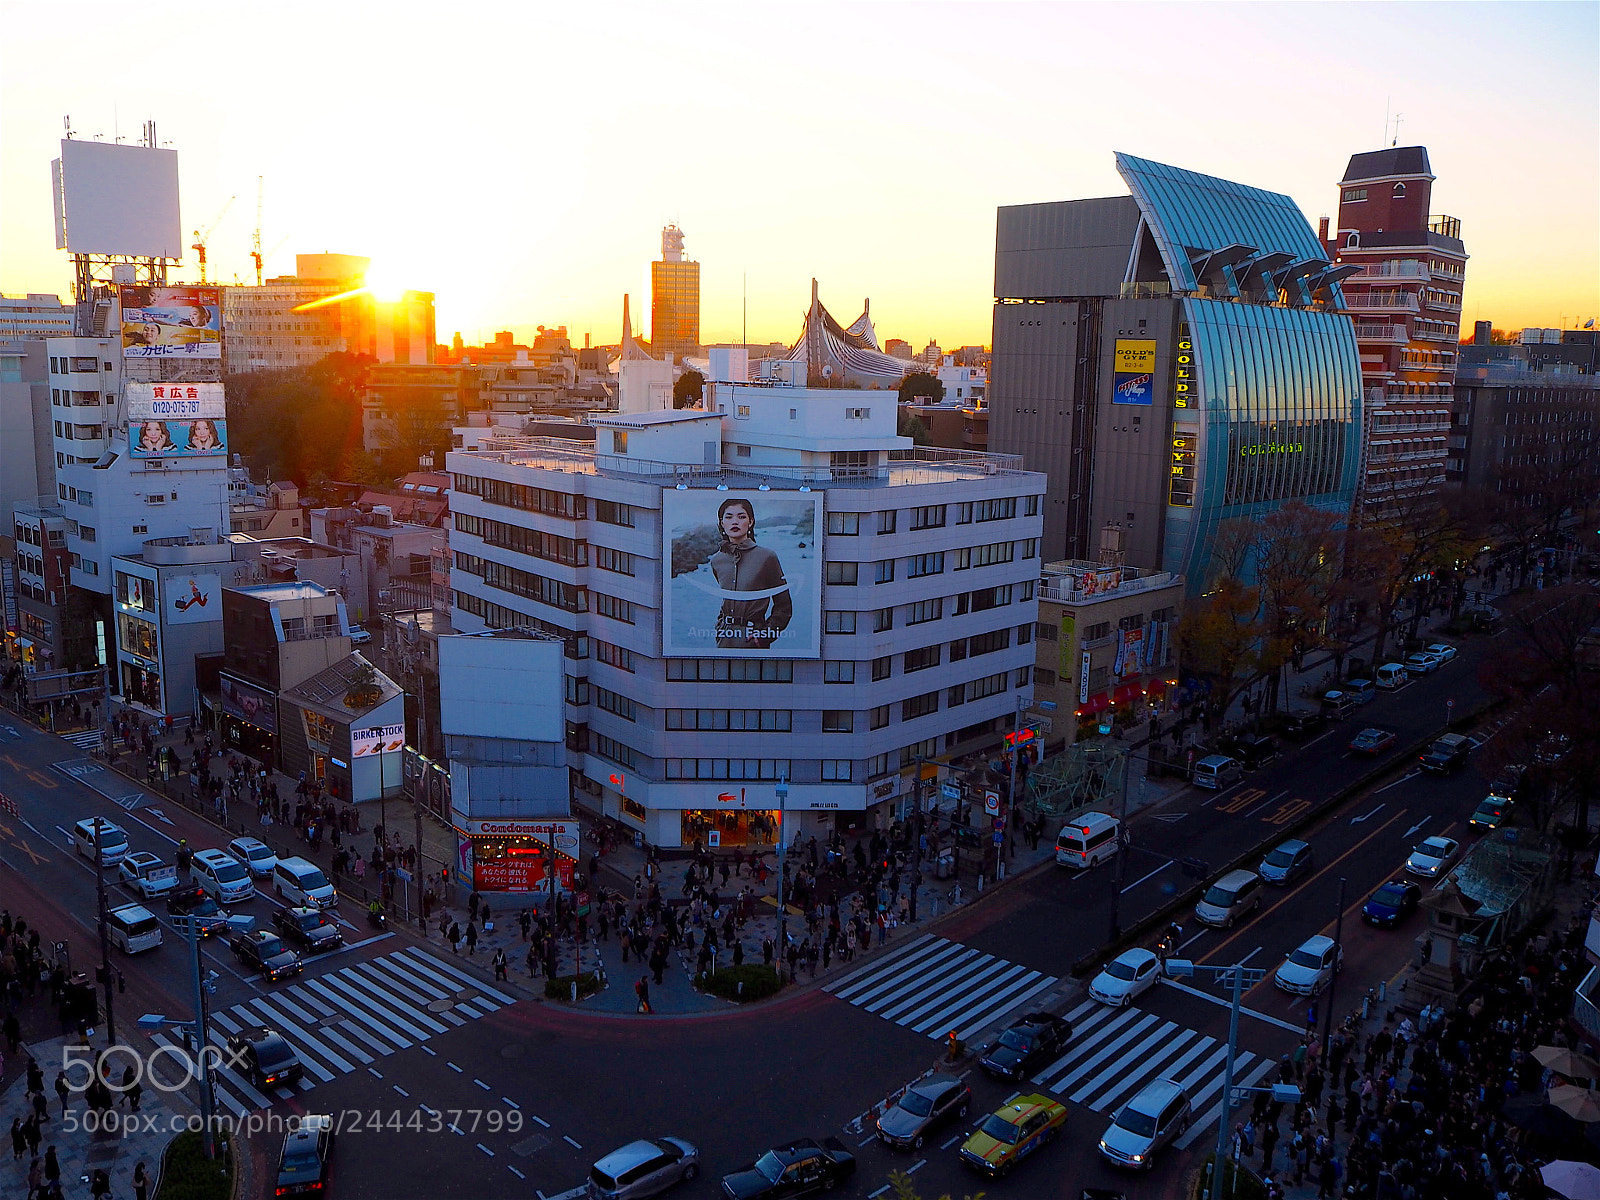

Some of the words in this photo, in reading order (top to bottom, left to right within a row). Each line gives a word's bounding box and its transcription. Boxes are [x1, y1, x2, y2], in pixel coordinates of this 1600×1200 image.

[1175, 340, 1192, 408] GOLD'S
[152, 386, 199, 399] 貸広告
[1172, 439, 1186, 475] GYM
[688, 627, 741, 638] Amazon
[746, 627, 796, 638] Fashion
[353, 725, 403, 741] BIRKENSTOCK
[480, 822, 566, 834] Condomania
